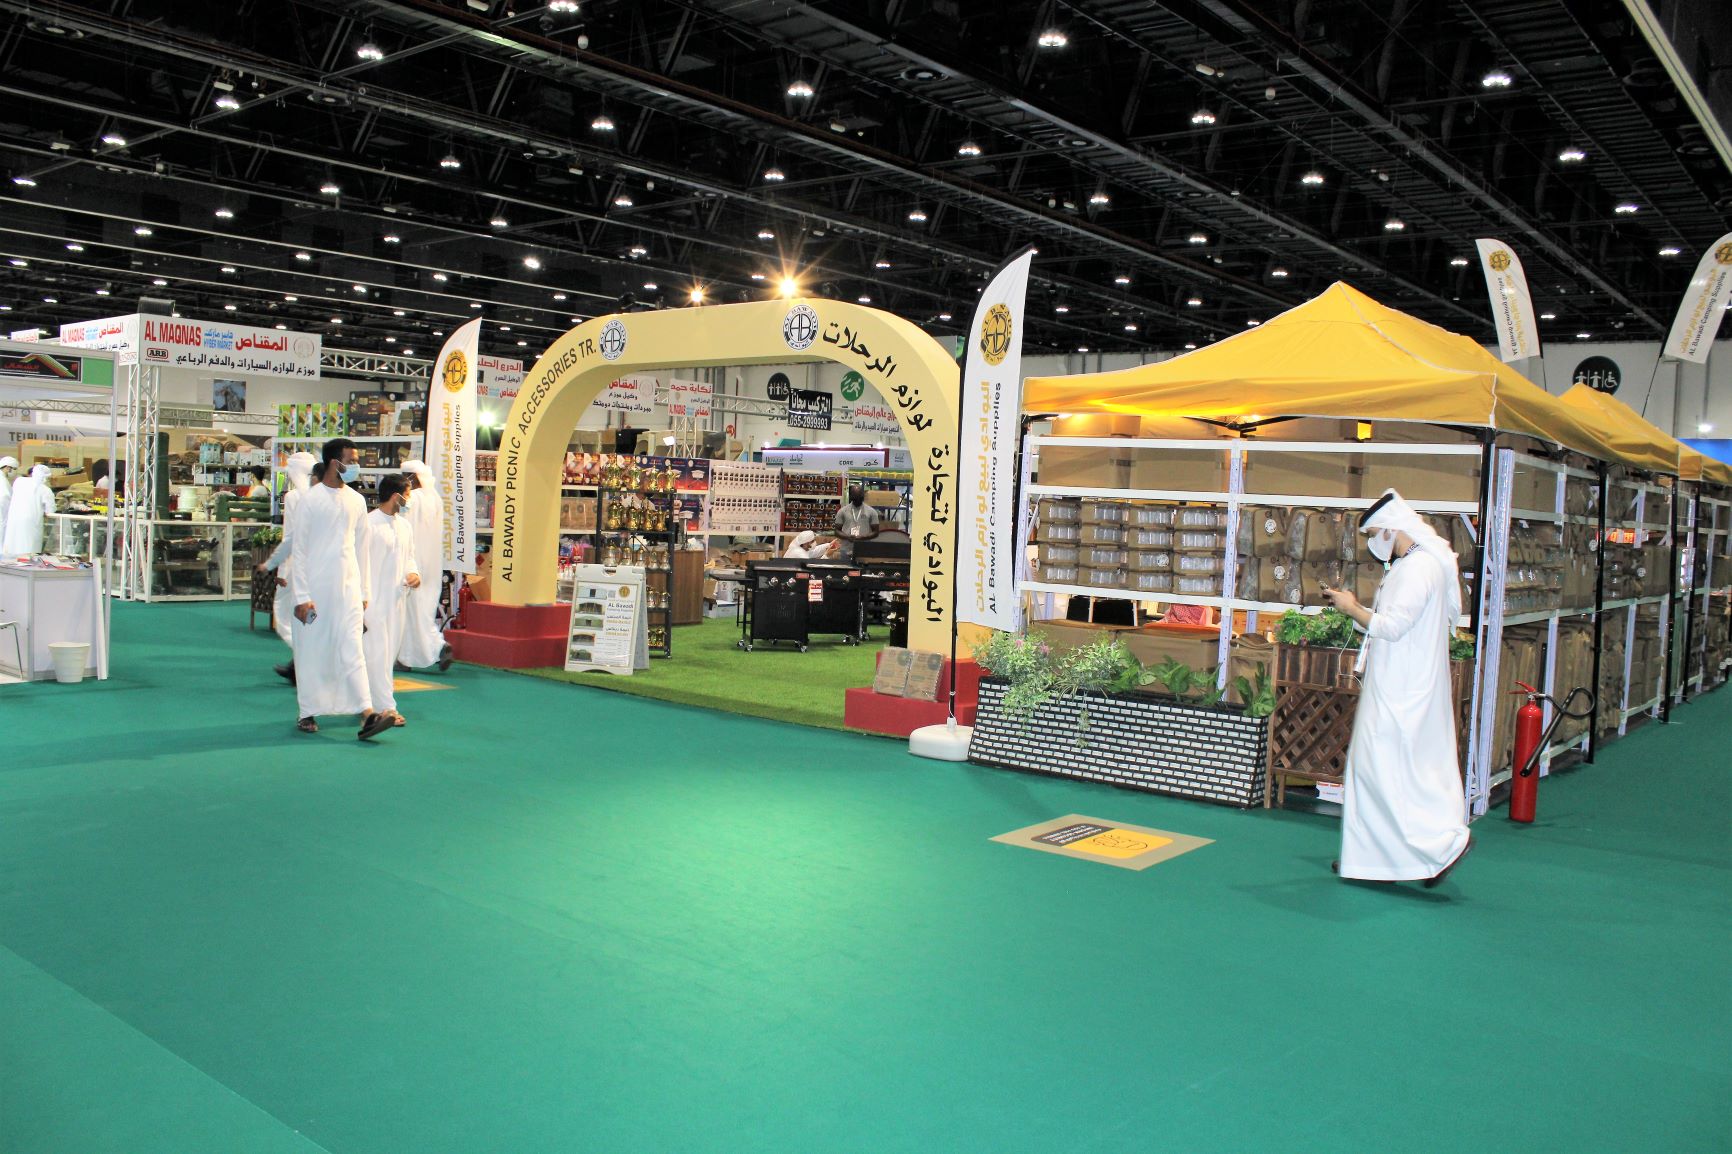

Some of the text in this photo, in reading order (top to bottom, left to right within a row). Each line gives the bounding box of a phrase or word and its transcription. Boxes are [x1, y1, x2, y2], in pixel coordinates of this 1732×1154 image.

[144, 320, 202, 346] AL MAQNAS
[235, 332, 288, 352] المقناص
[149, 350, 166, 358] ARB
[176, 353, 206, 365] الرباعي
[208, 354, 234, 368] والدفع
[237, 360, 272, 371] السيارات
[272, 362, 294, 374] للوازم
[808, 396, 831, 414] التركيب
[979, 381, 990, 452] البوادي
[502, 338, 597, 582] AL BAWADY PICNIC ACCESSORIES TR.
[822, 322, 950, 622] البوادي لتجارة لوازم الرحلات
[977, 454, 990, 490] لبيع
[454, 404, 465, 562] AL Bawadi Camping Supplies
[988, 382, 1002, 614] AL Bawadi Camping Supplies
[974, 548, 986, 613] الرحلات
